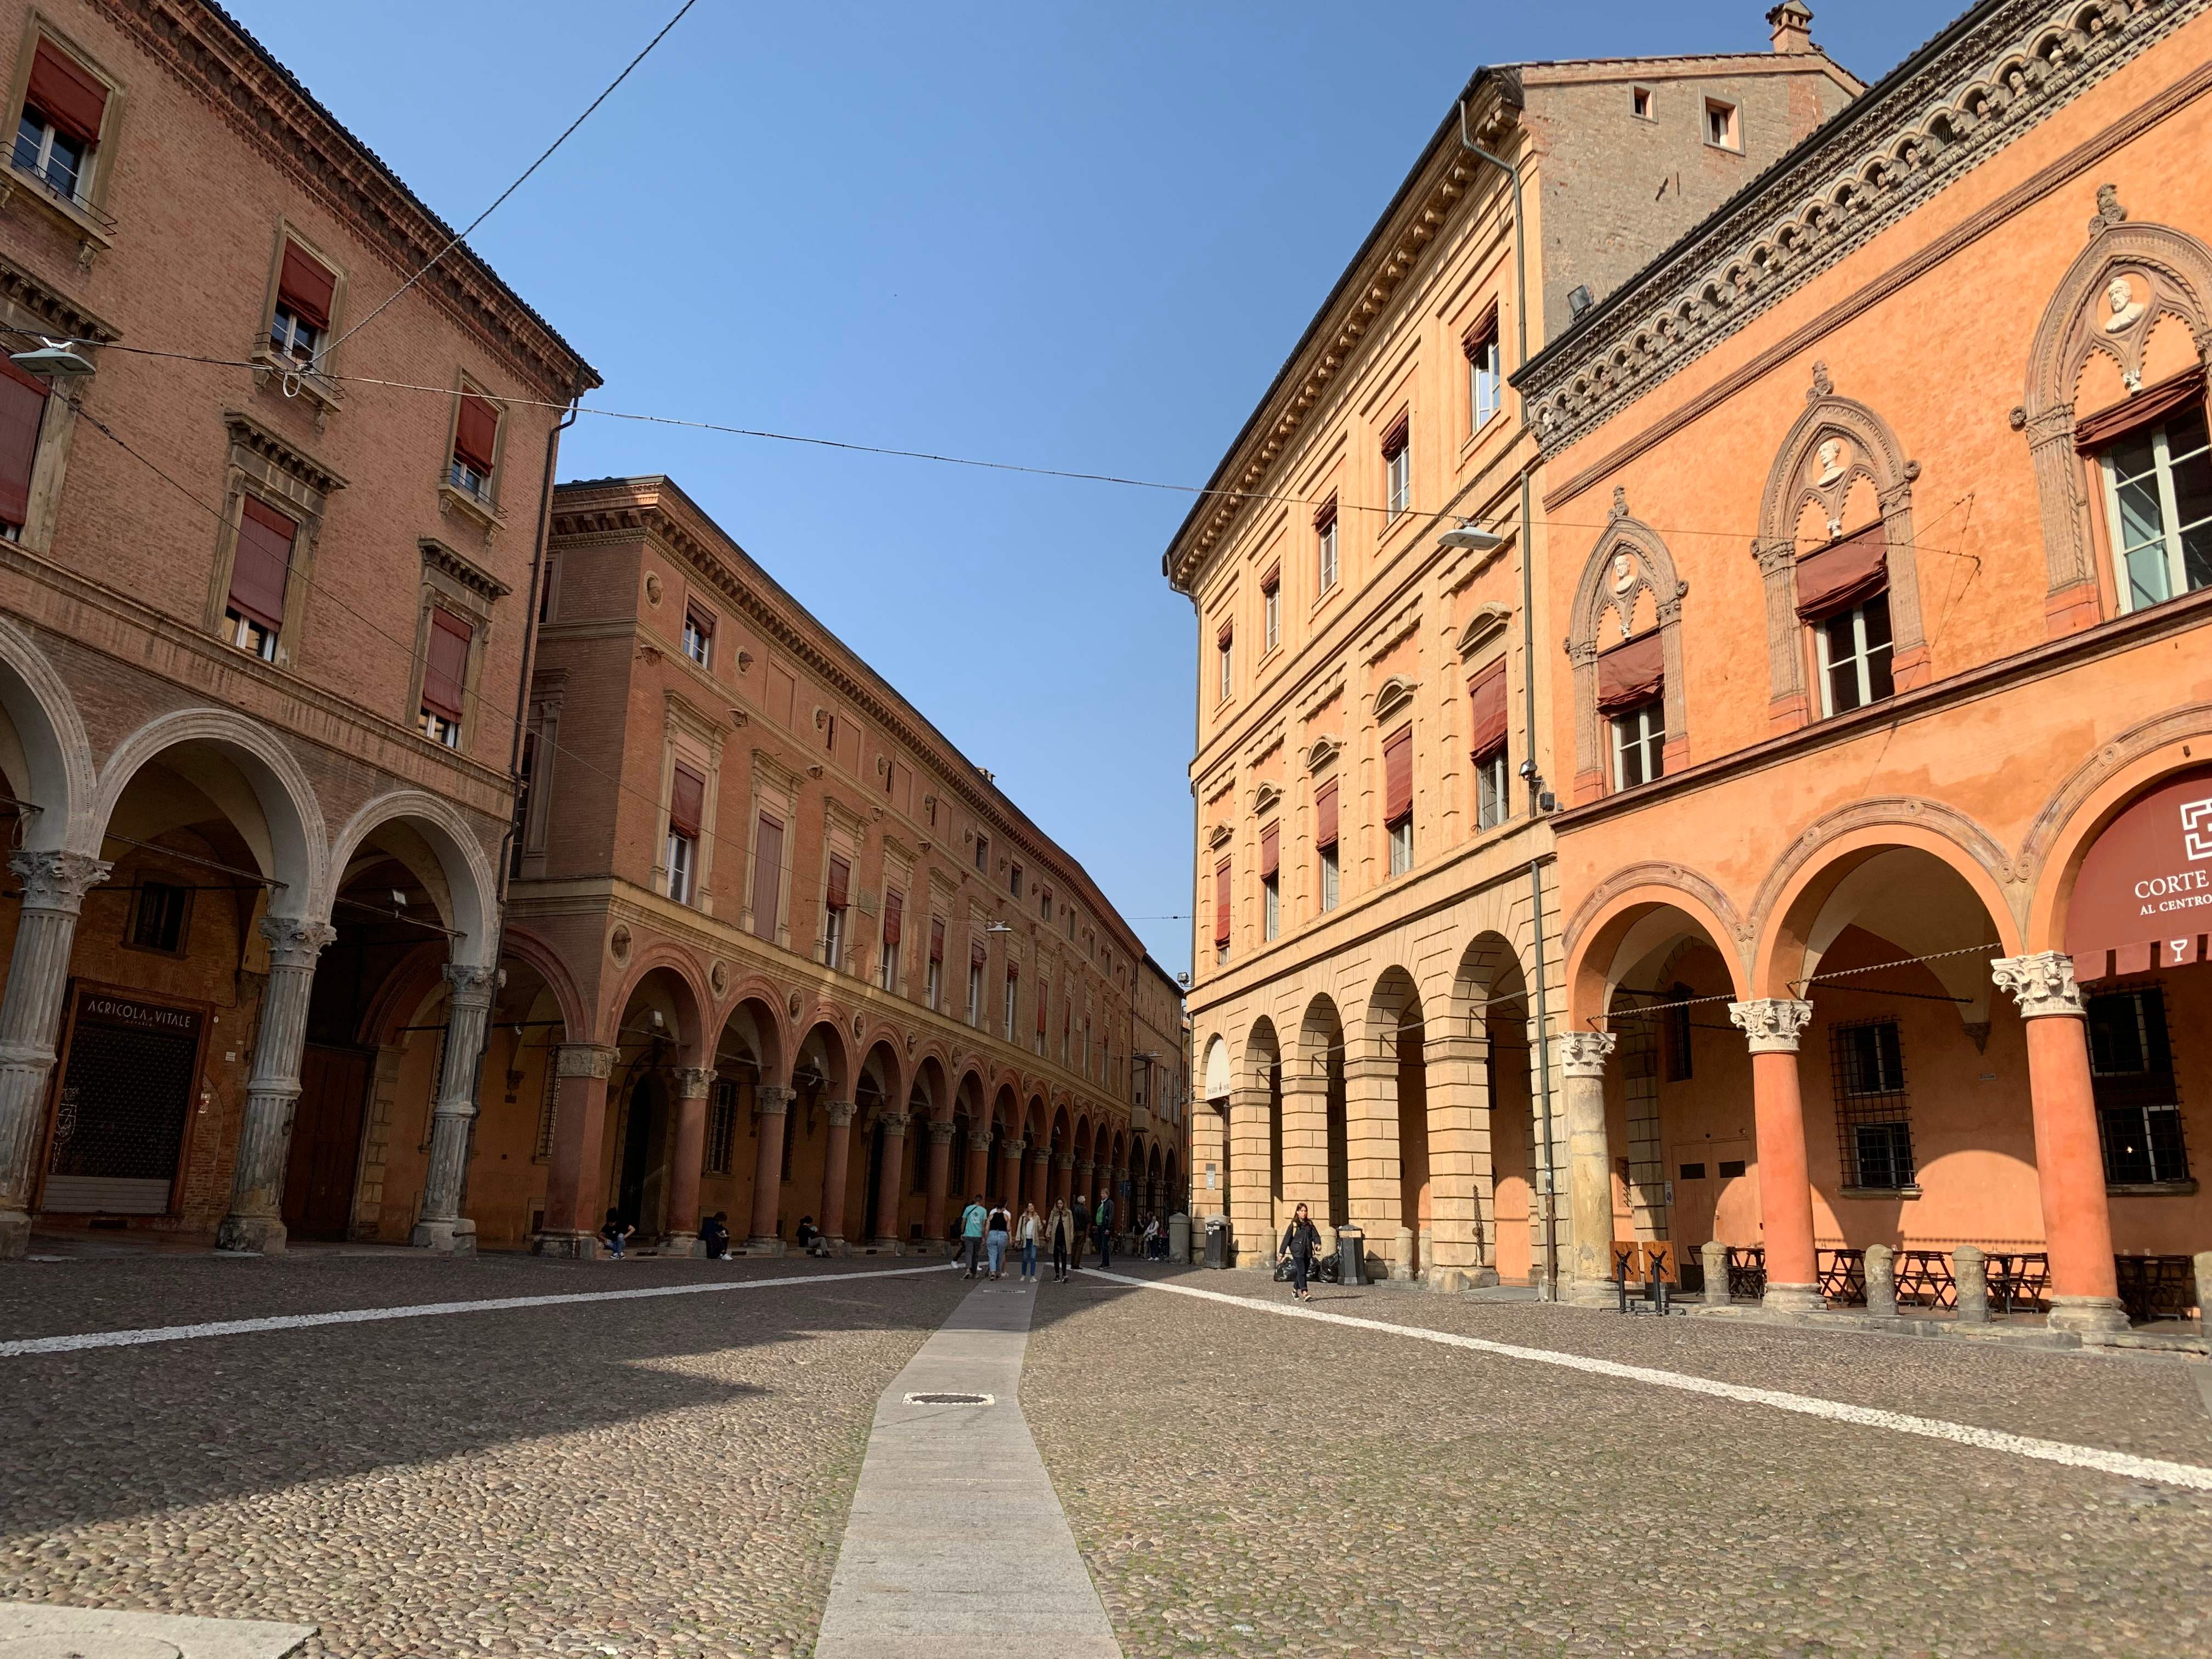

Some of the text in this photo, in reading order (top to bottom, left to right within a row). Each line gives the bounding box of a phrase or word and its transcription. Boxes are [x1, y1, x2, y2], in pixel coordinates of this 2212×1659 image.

[2135, 870, 2209, 898] CORTE
[2140, 894, 2212, 916] AL CENTRO
[88, 1000, 146, 1020] AGRICOLA
[156, 1011, 191, 1028] VITALE
